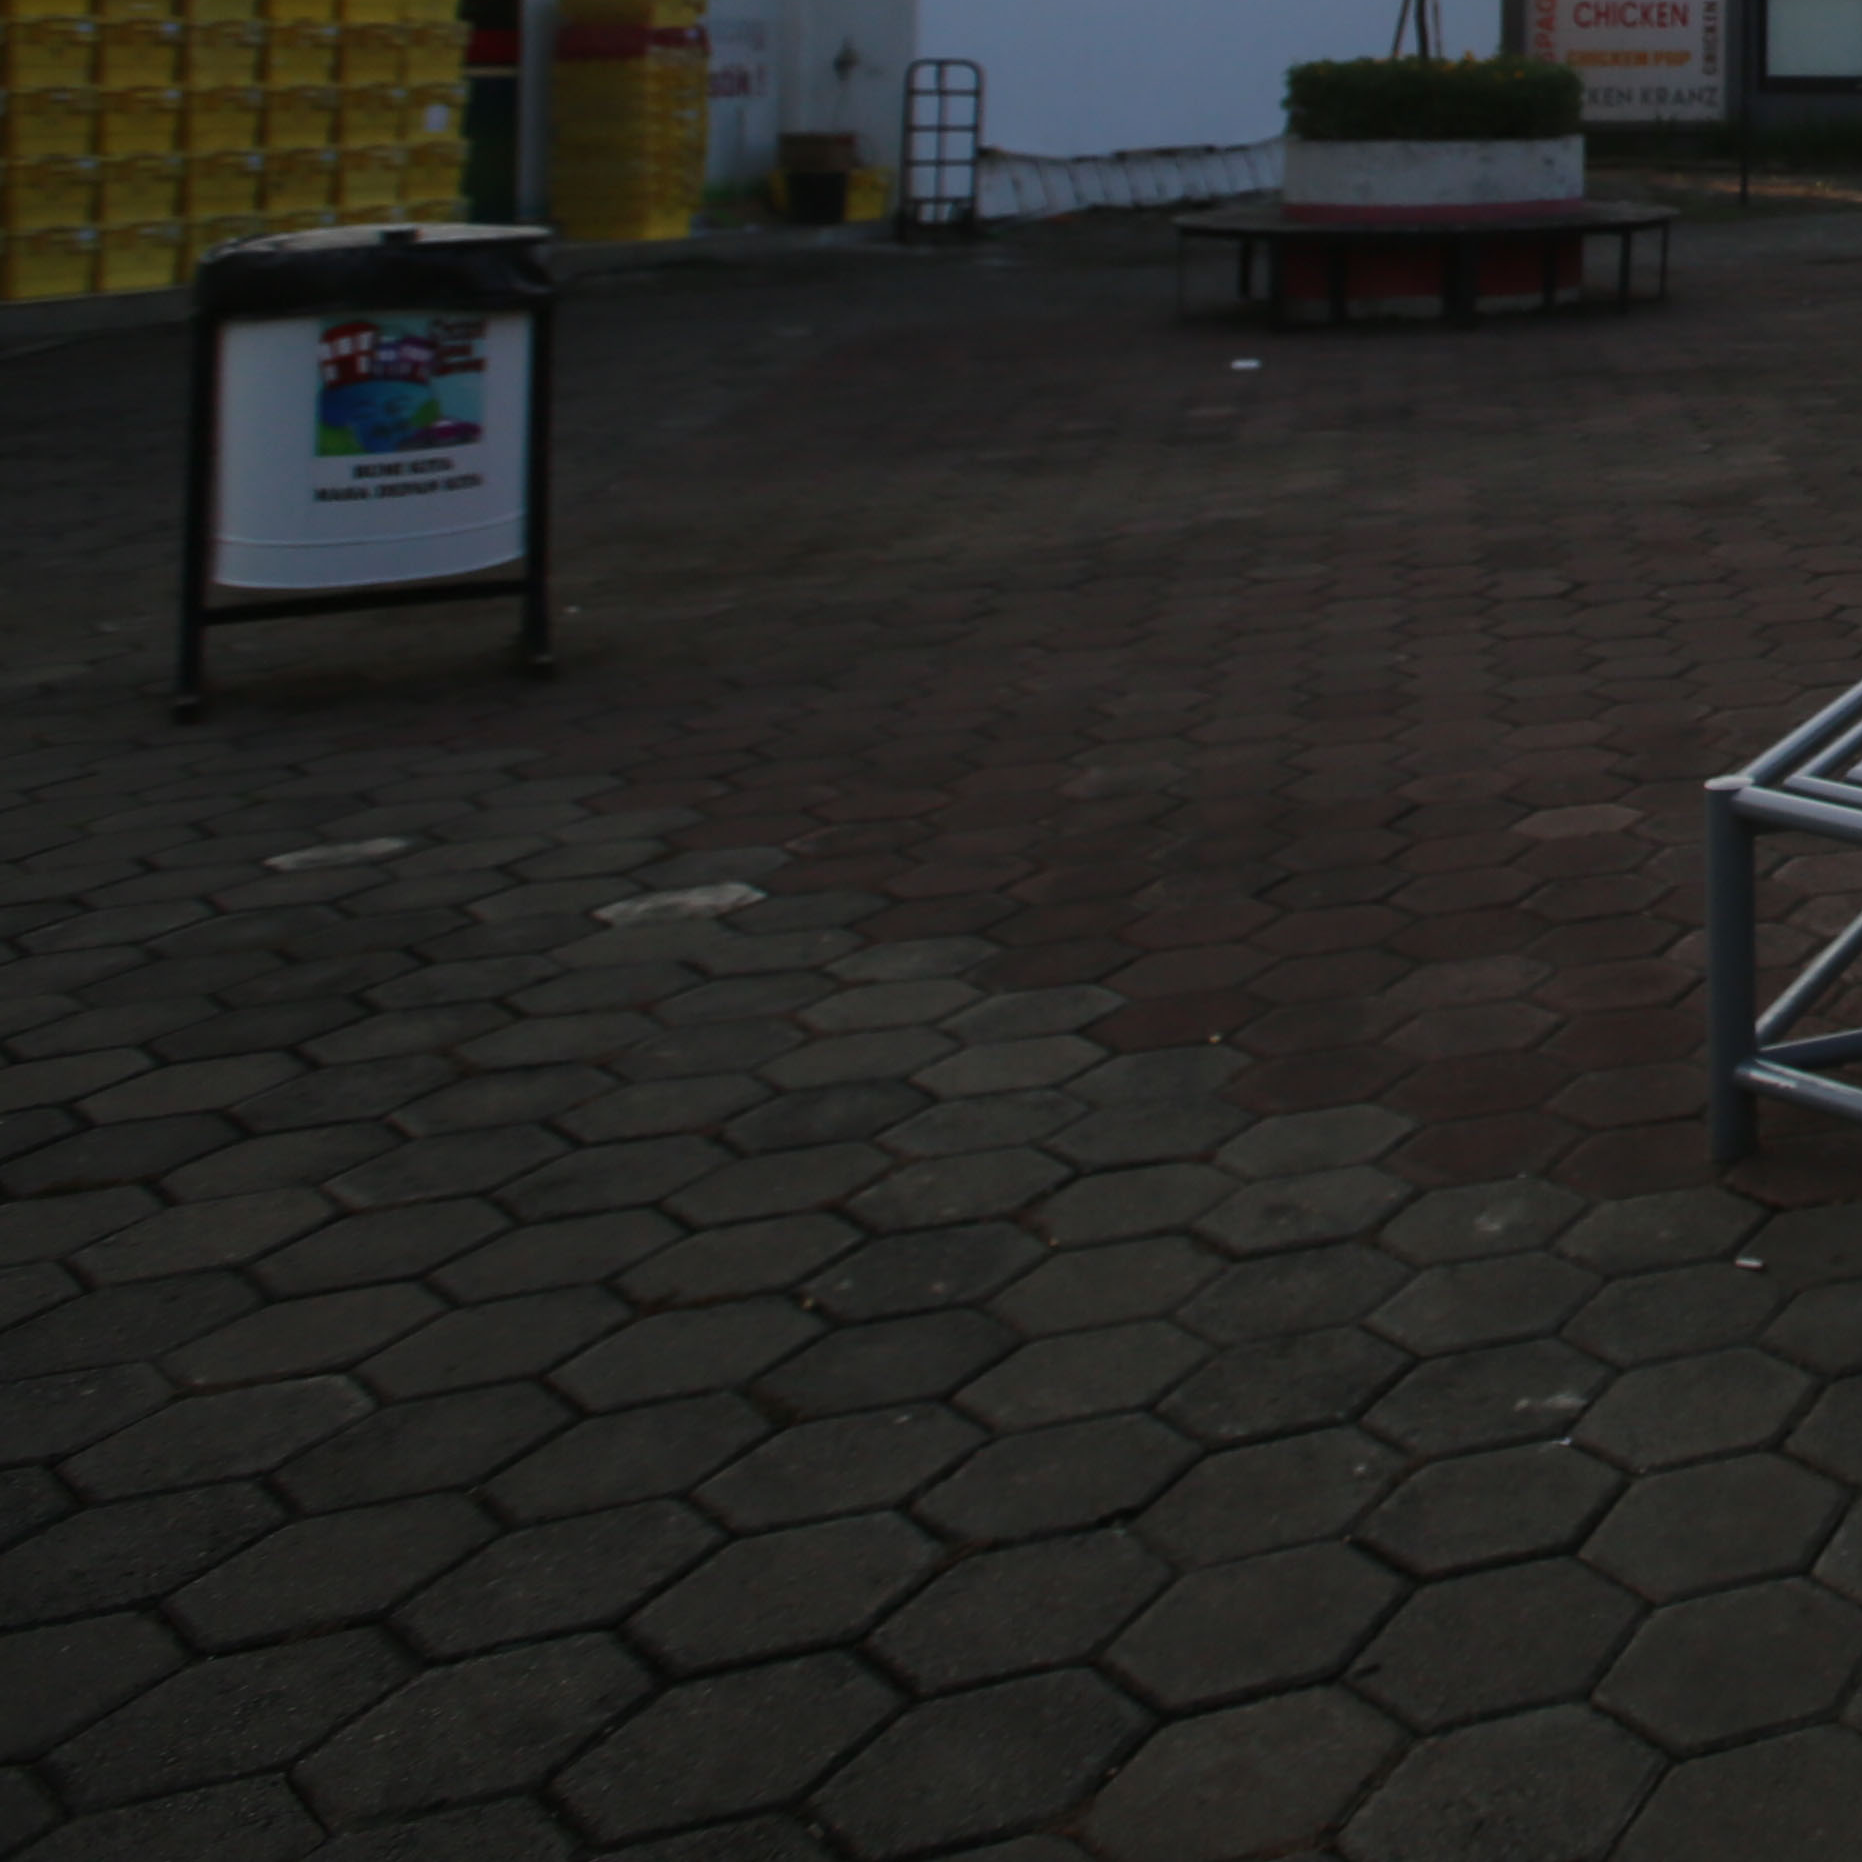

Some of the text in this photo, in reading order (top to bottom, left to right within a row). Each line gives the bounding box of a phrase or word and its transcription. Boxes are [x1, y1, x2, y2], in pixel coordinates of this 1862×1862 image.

[1573, 2, 1690, 28] CHICKEN
[1702, 1, 1719, 75] CHICKEN
[1640, 87, 1720, 107] KRANZ
